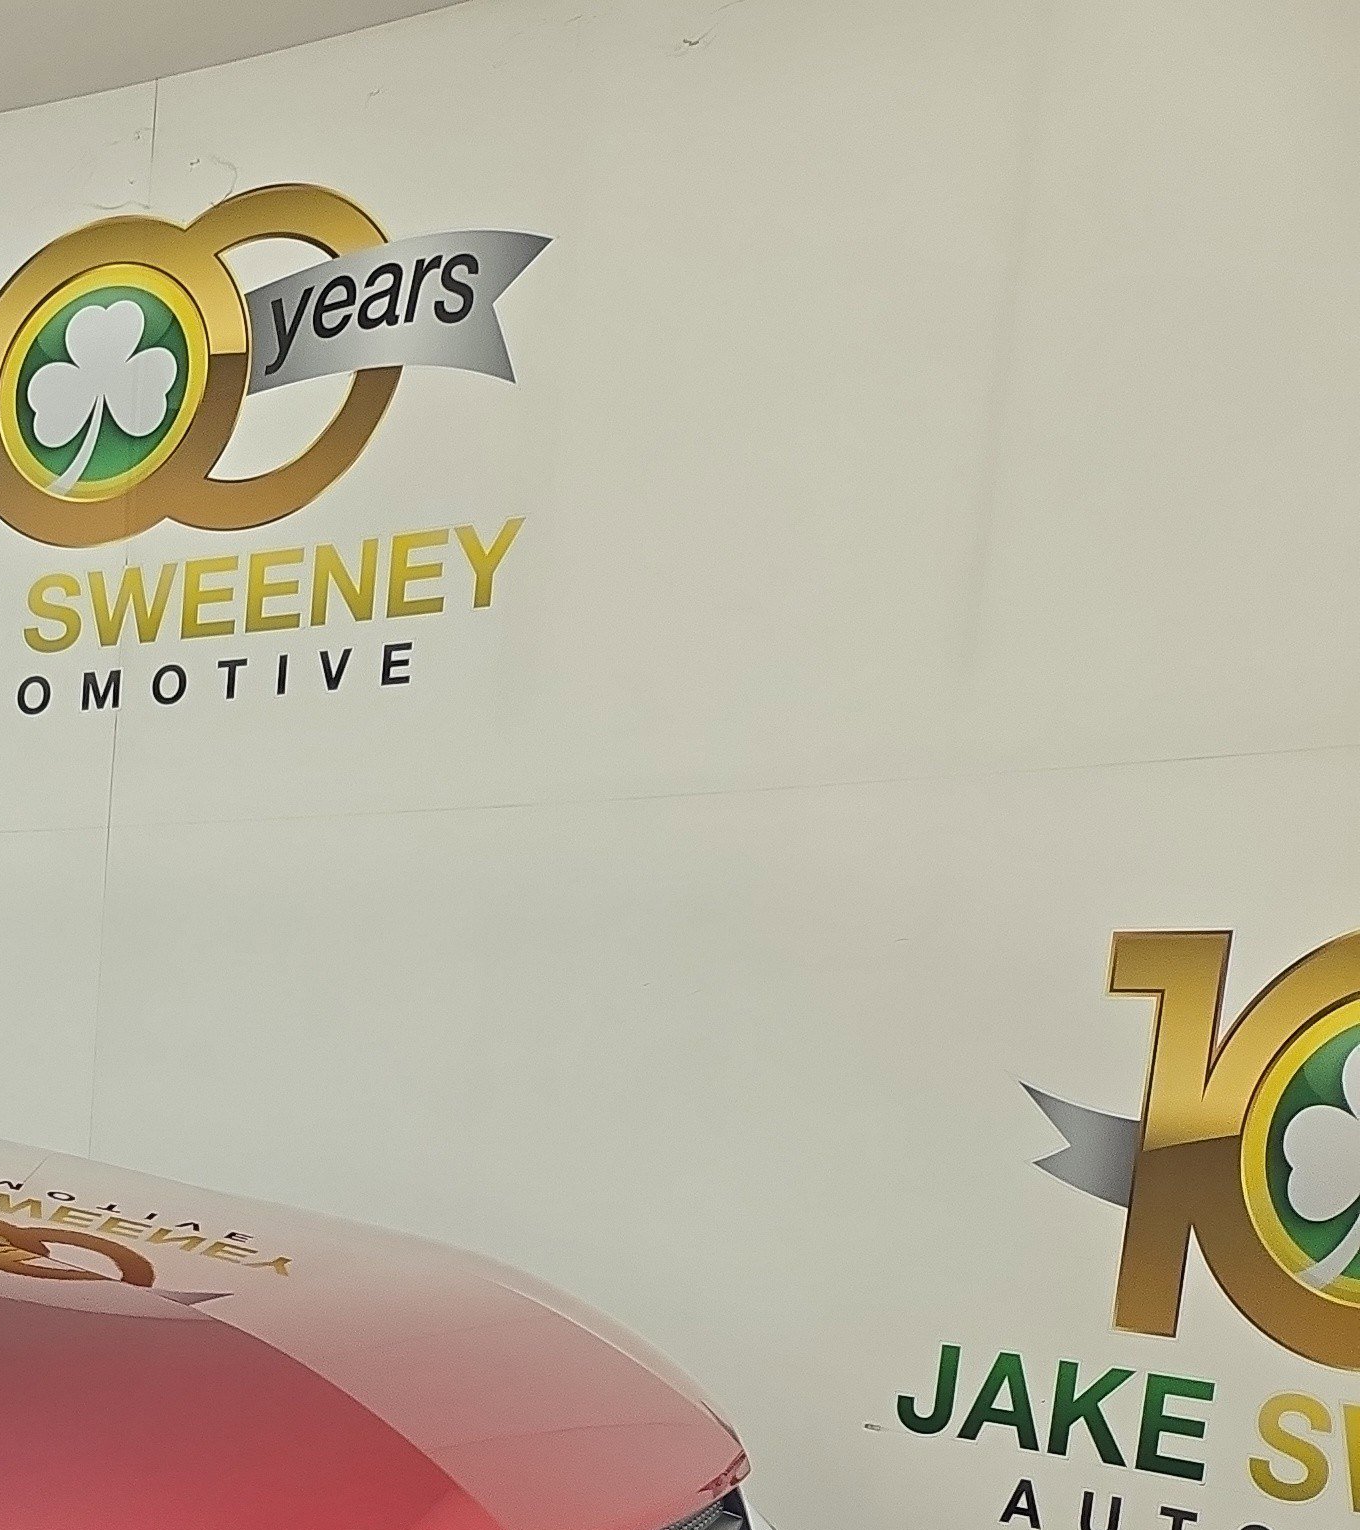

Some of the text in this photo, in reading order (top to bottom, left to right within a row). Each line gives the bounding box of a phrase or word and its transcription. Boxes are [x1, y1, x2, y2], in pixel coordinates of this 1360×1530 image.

[265, 252, 480, 375] years
[23, 517, 525, 653] SWEENEY
[897, 1343, 1360, 1513] JAKE S
